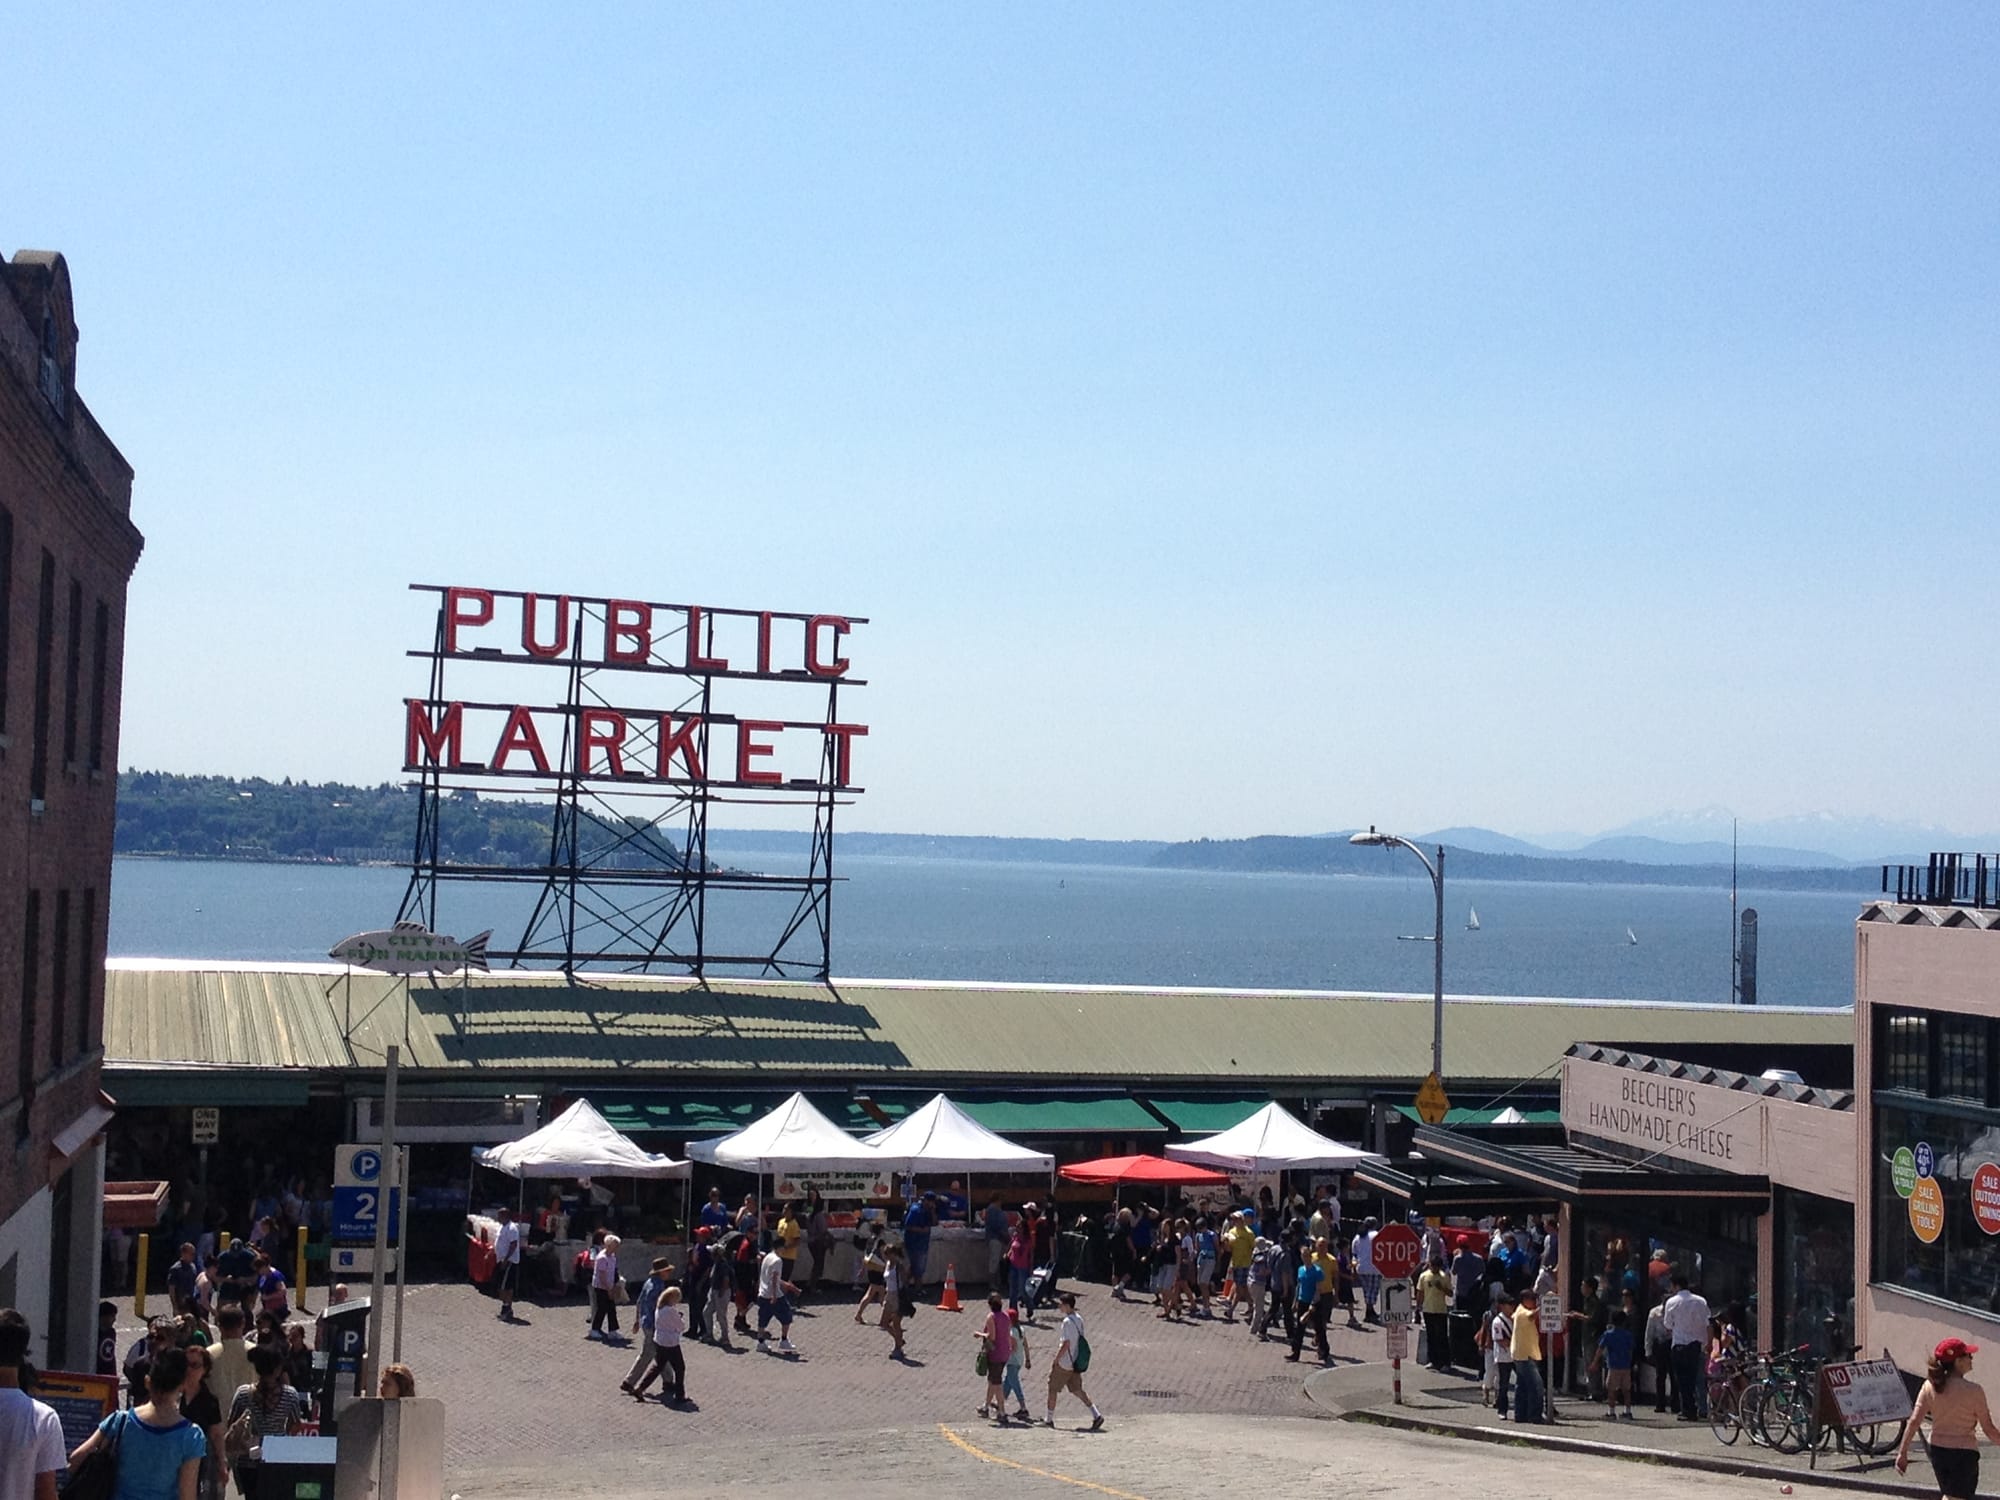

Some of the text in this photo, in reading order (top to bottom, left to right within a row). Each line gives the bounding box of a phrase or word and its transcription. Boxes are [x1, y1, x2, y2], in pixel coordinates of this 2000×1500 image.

[446, 587, 851, 677] PUBLIC
[405, 699, 869, 786] MARKET
[1621, 1077, 1696, 1117] BEECHER'S
[195, 1110, 217, 1119] ONE
[195, 1120, 217, 1129] WAY
[1589, 1101, 1734, 1160] HANDMADE CHEESE
[361, 1155, 377, 1175] P
[1982, 1174, 1999, 1190] SALE
[1918, 1185, 1935, 1200] SALE
[354, 1192, 376, 1220] 2
[1912, 1200, 1940, 1217] GRILLING
[1917, 1215, 1936, 1230] TOOLS
[1375, 1241, 1418, 1262] STOP
[1384, 1311, 1409, 1321] ONLY
[343, 1331, 359, 1353] P
[1828, 1362, 1895, 1385] NO PARKING
